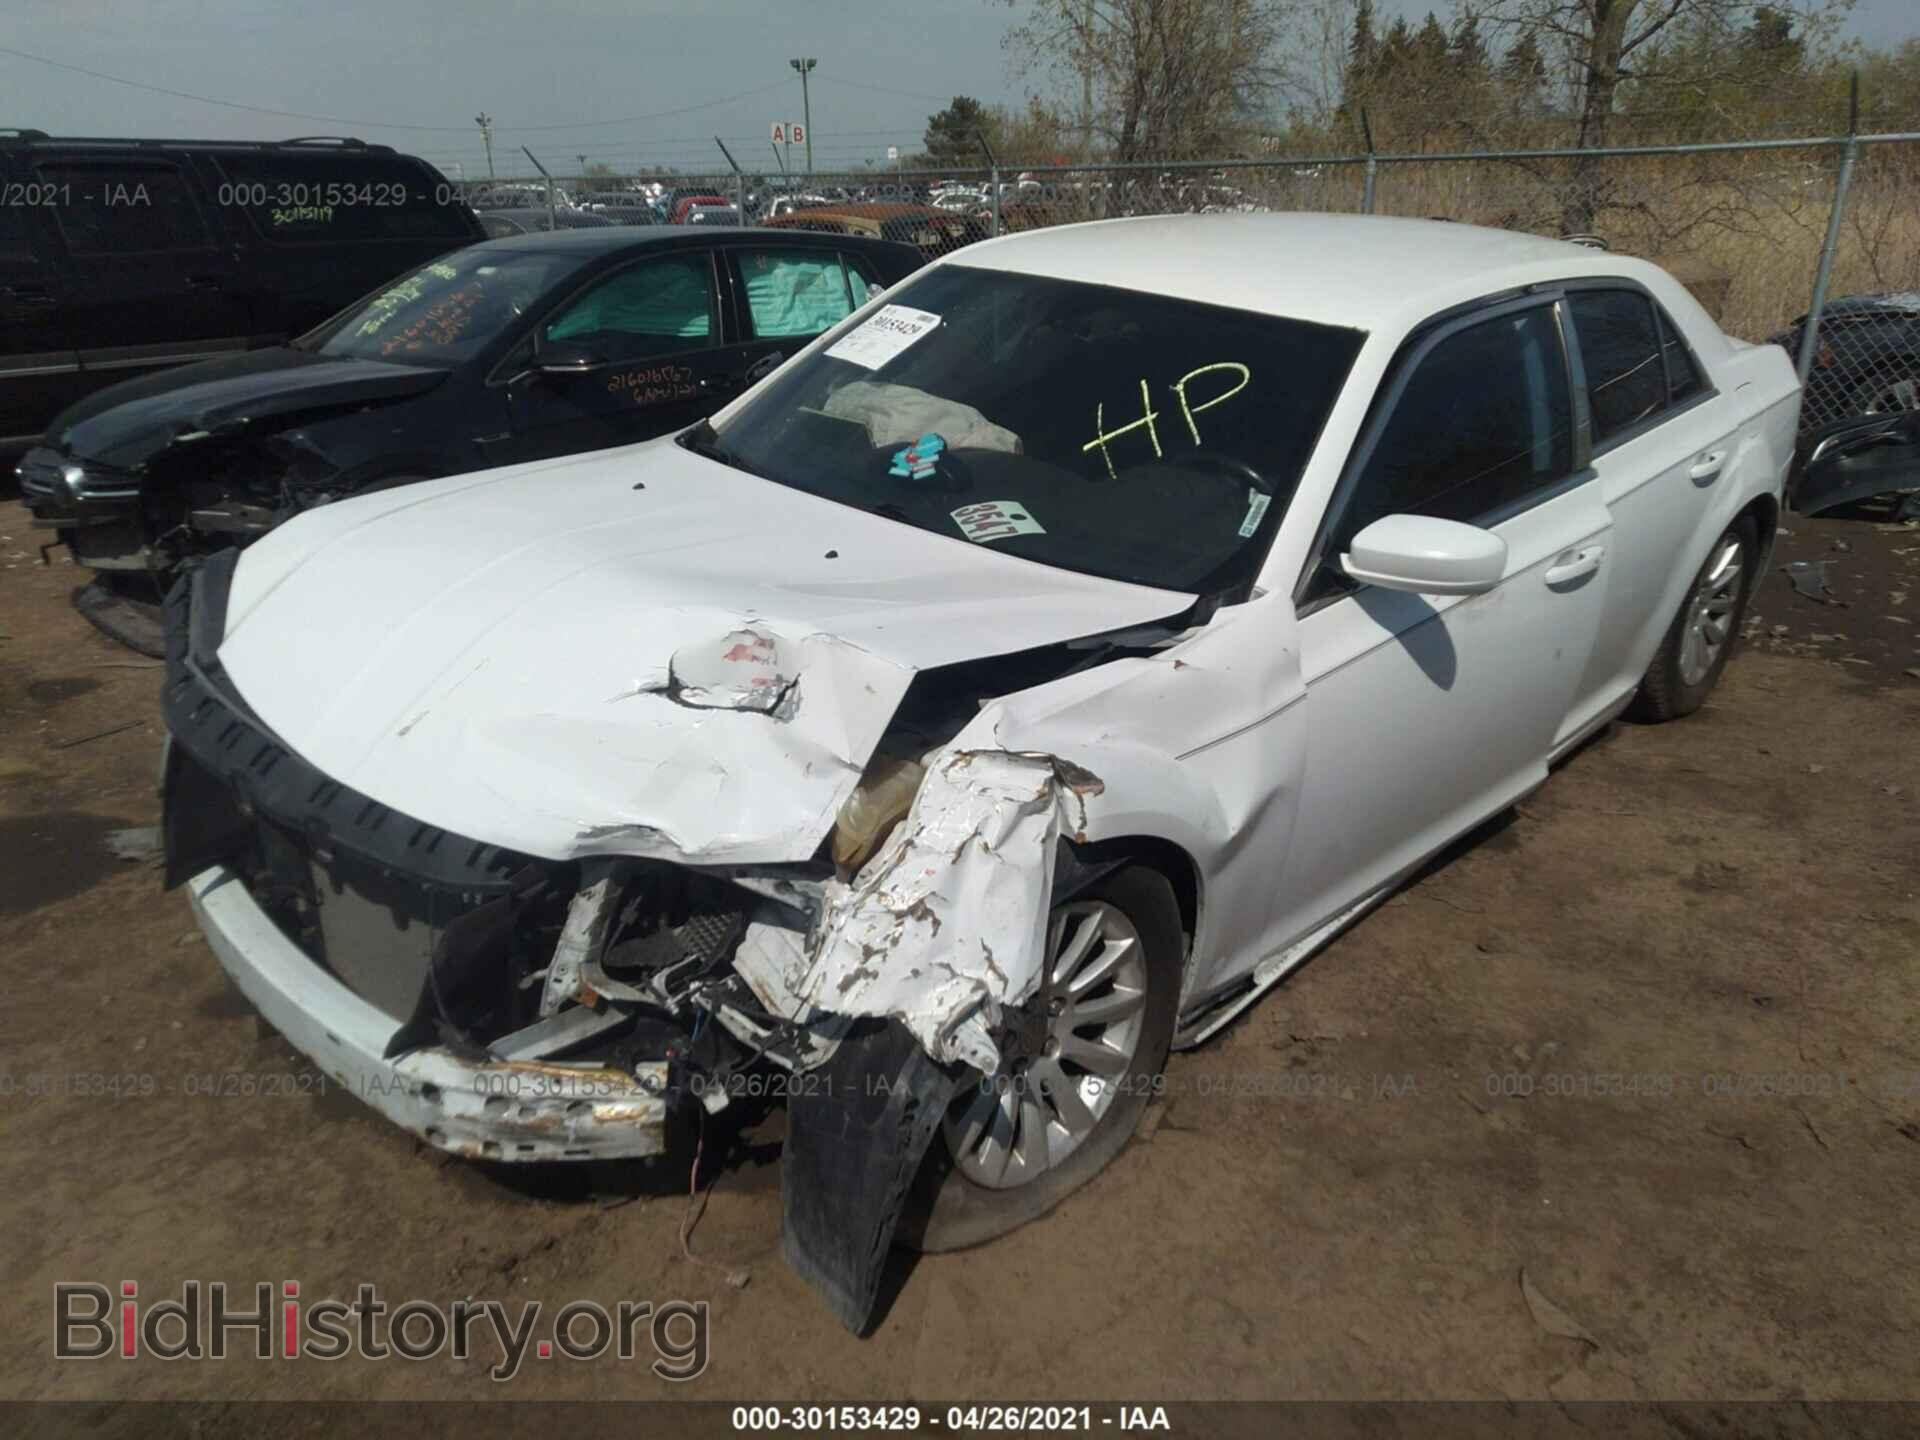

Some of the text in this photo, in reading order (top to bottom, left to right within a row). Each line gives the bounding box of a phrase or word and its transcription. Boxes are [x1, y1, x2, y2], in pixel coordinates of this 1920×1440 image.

[773, 125, 784, 142] A
[793, 127, 804, 143] B
[1082, 361, 1250, 480] HP
